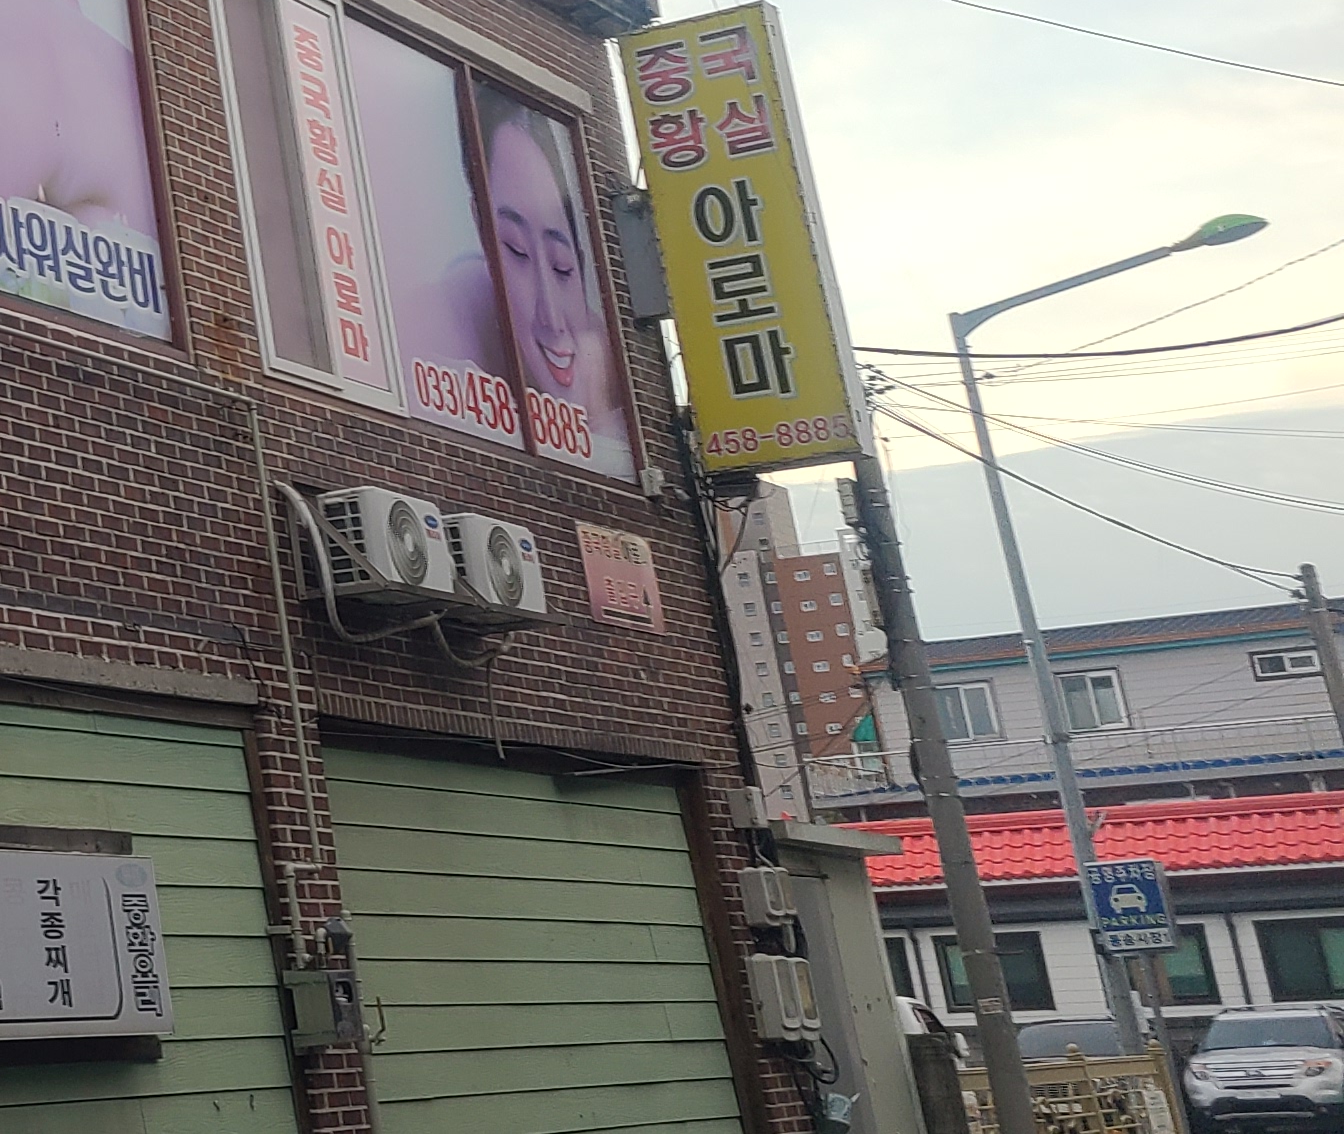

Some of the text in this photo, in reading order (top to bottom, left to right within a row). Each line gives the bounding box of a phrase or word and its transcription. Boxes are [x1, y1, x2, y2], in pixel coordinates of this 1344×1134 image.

[293, 24, 369, 362] 중국황실 아로마
[692, 178, 795, 399] 아로마
[706, 414, 849, 457] 458-8885
[1101, 913, 1166, 928] PARKING
